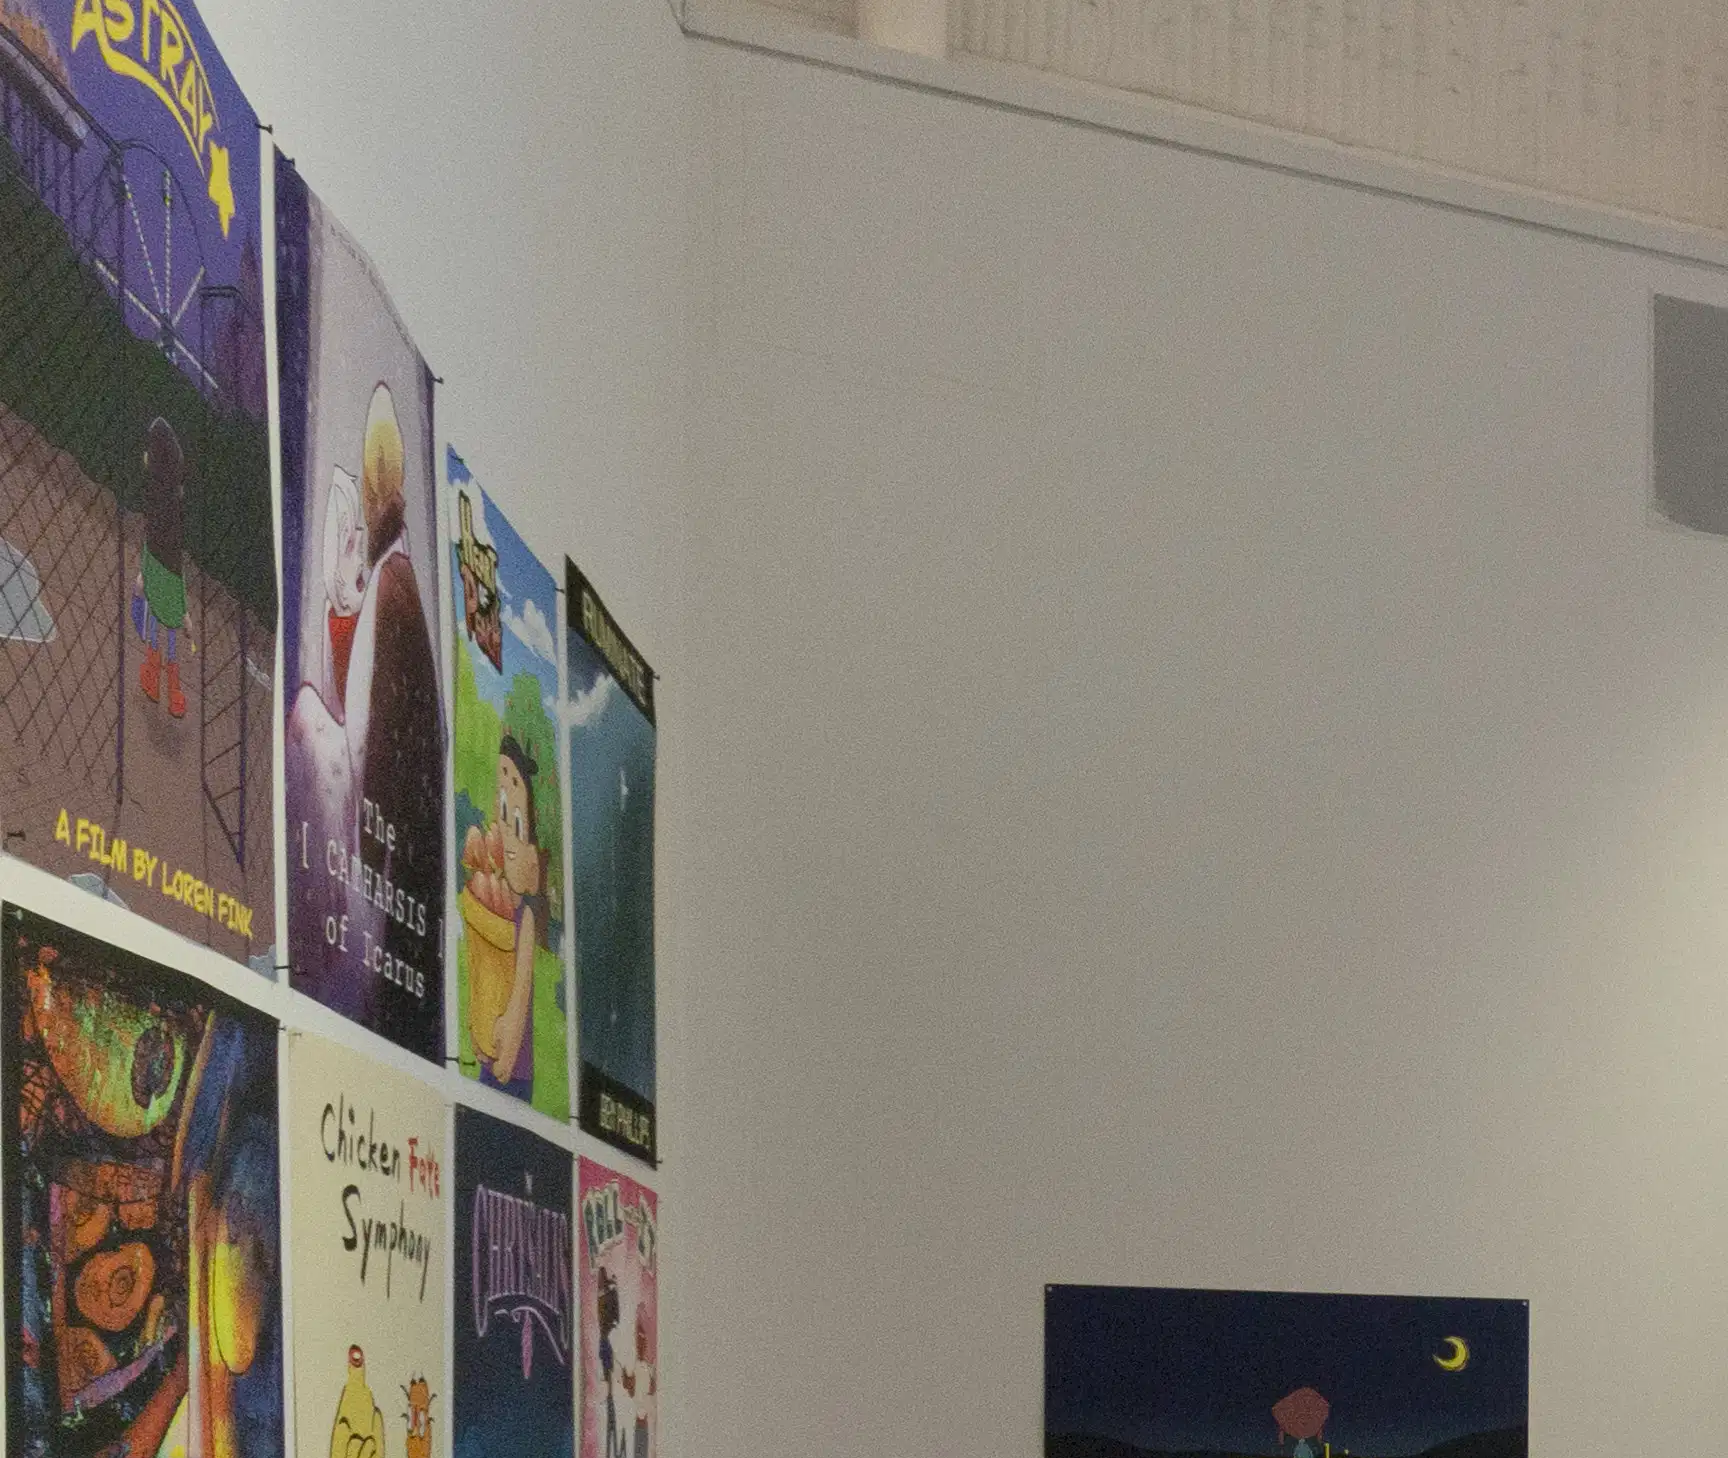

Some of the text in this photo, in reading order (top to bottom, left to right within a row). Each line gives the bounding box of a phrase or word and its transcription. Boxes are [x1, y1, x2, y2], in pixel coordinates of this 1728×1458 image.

[364, 797, 396, 850] The
[55, 808, 254, 939] A FILM BY LOREN FINK
[326, 839, 426, 936] CATHARSIS
[326, 916, 425, 998] of Icarus
[321, 1092, 400, 1183] Chicken
[342, 1184, 430, 1304] Symphony
